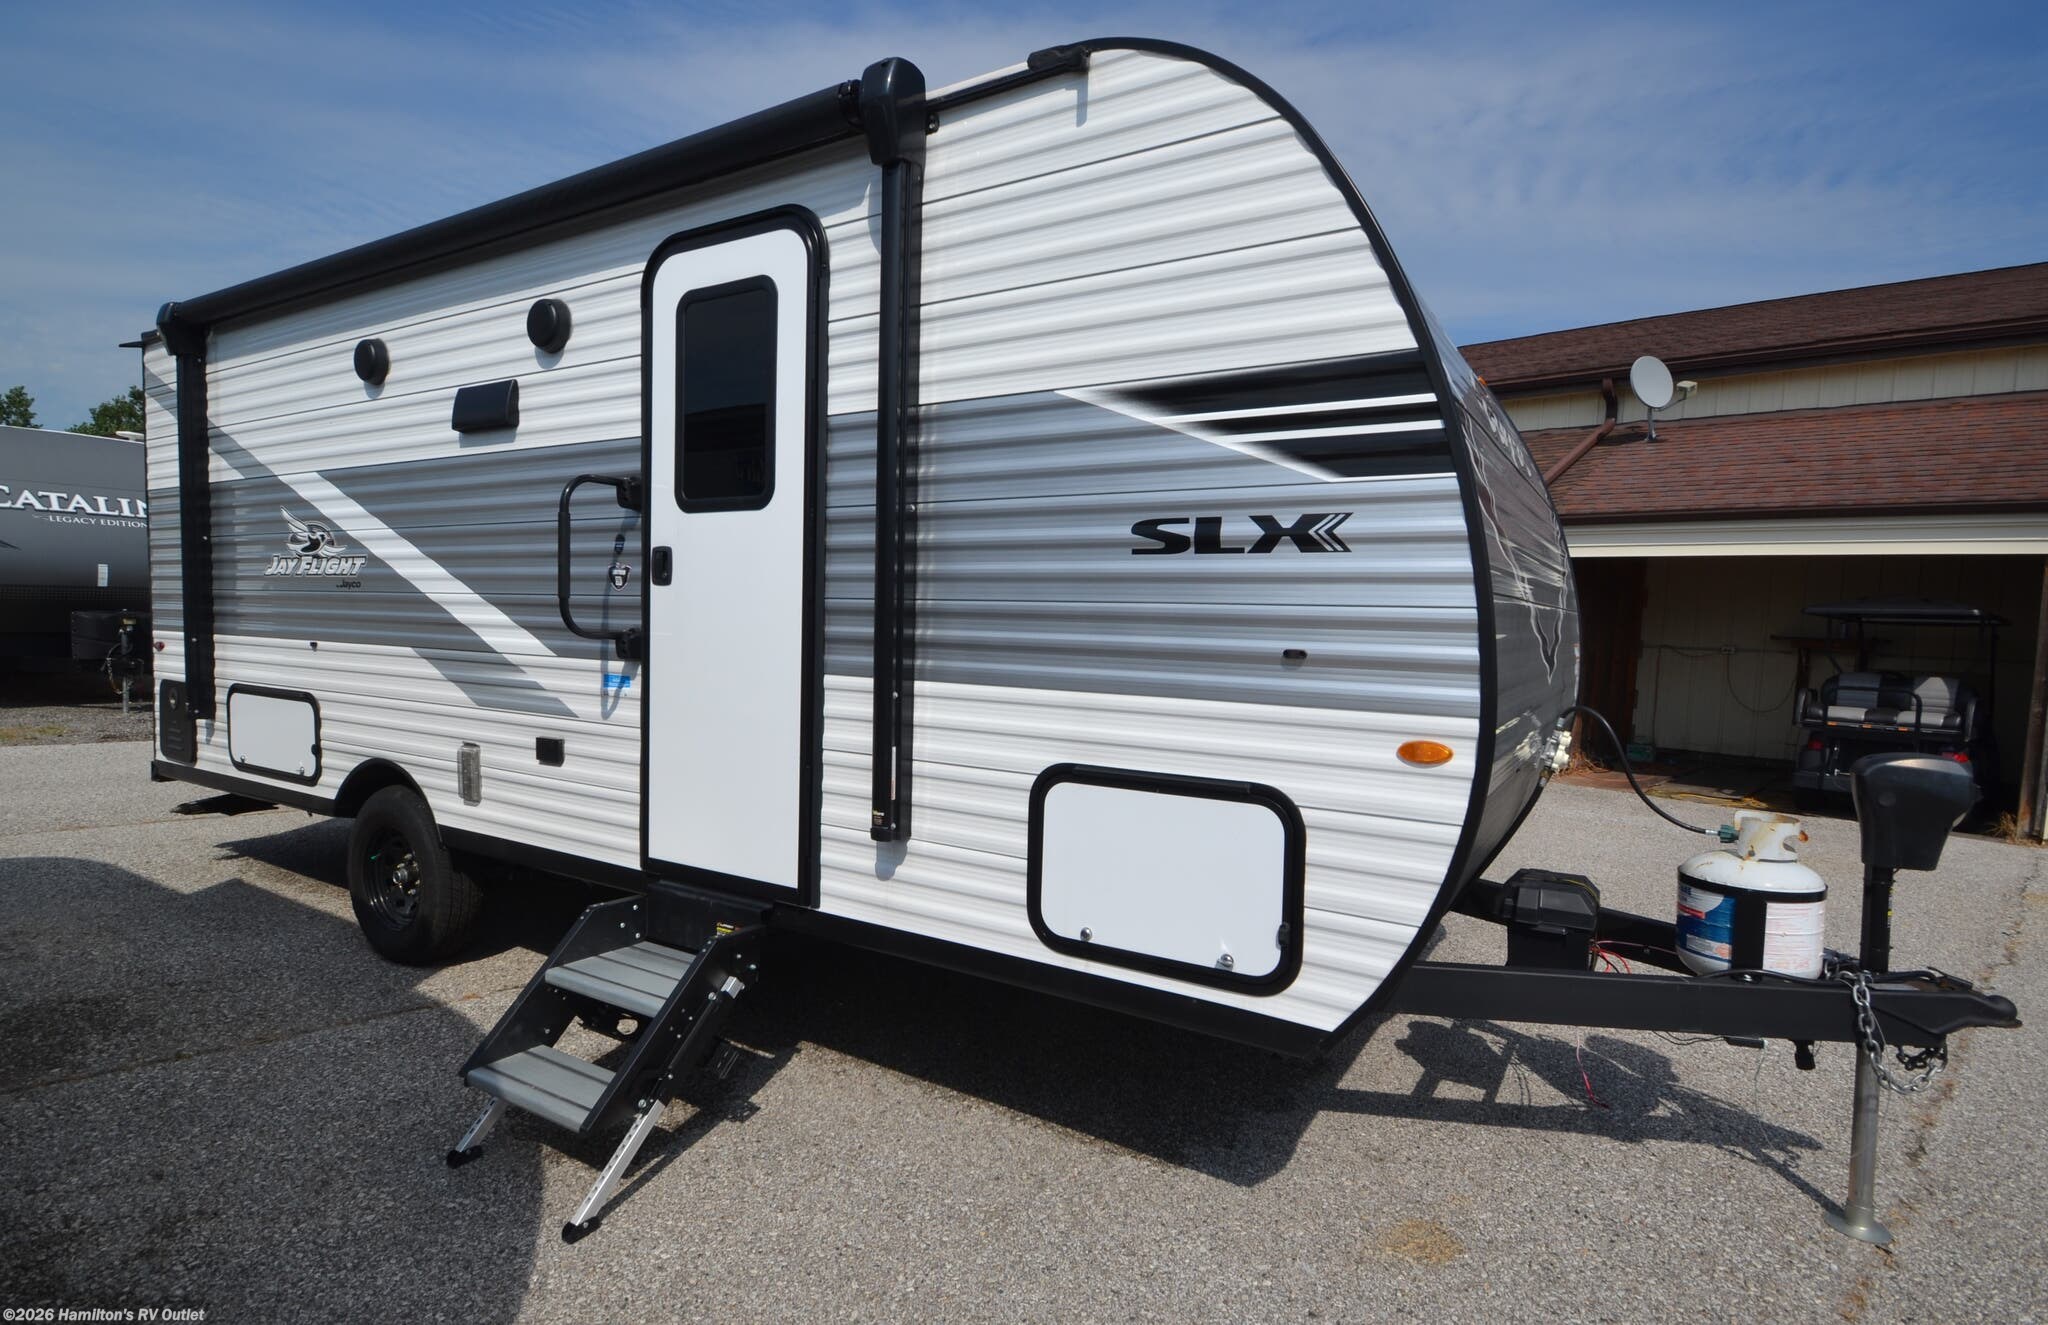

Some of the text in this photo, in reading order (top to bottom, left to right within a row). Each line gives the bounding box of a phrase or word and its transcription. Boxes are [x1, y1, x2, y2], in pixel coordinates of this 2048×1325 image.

[49, 515, 96, 525] LEGACY
[1131, 512, 1353, 555] SLX
[264, 555, 365, 576] JAY FLIGHT
